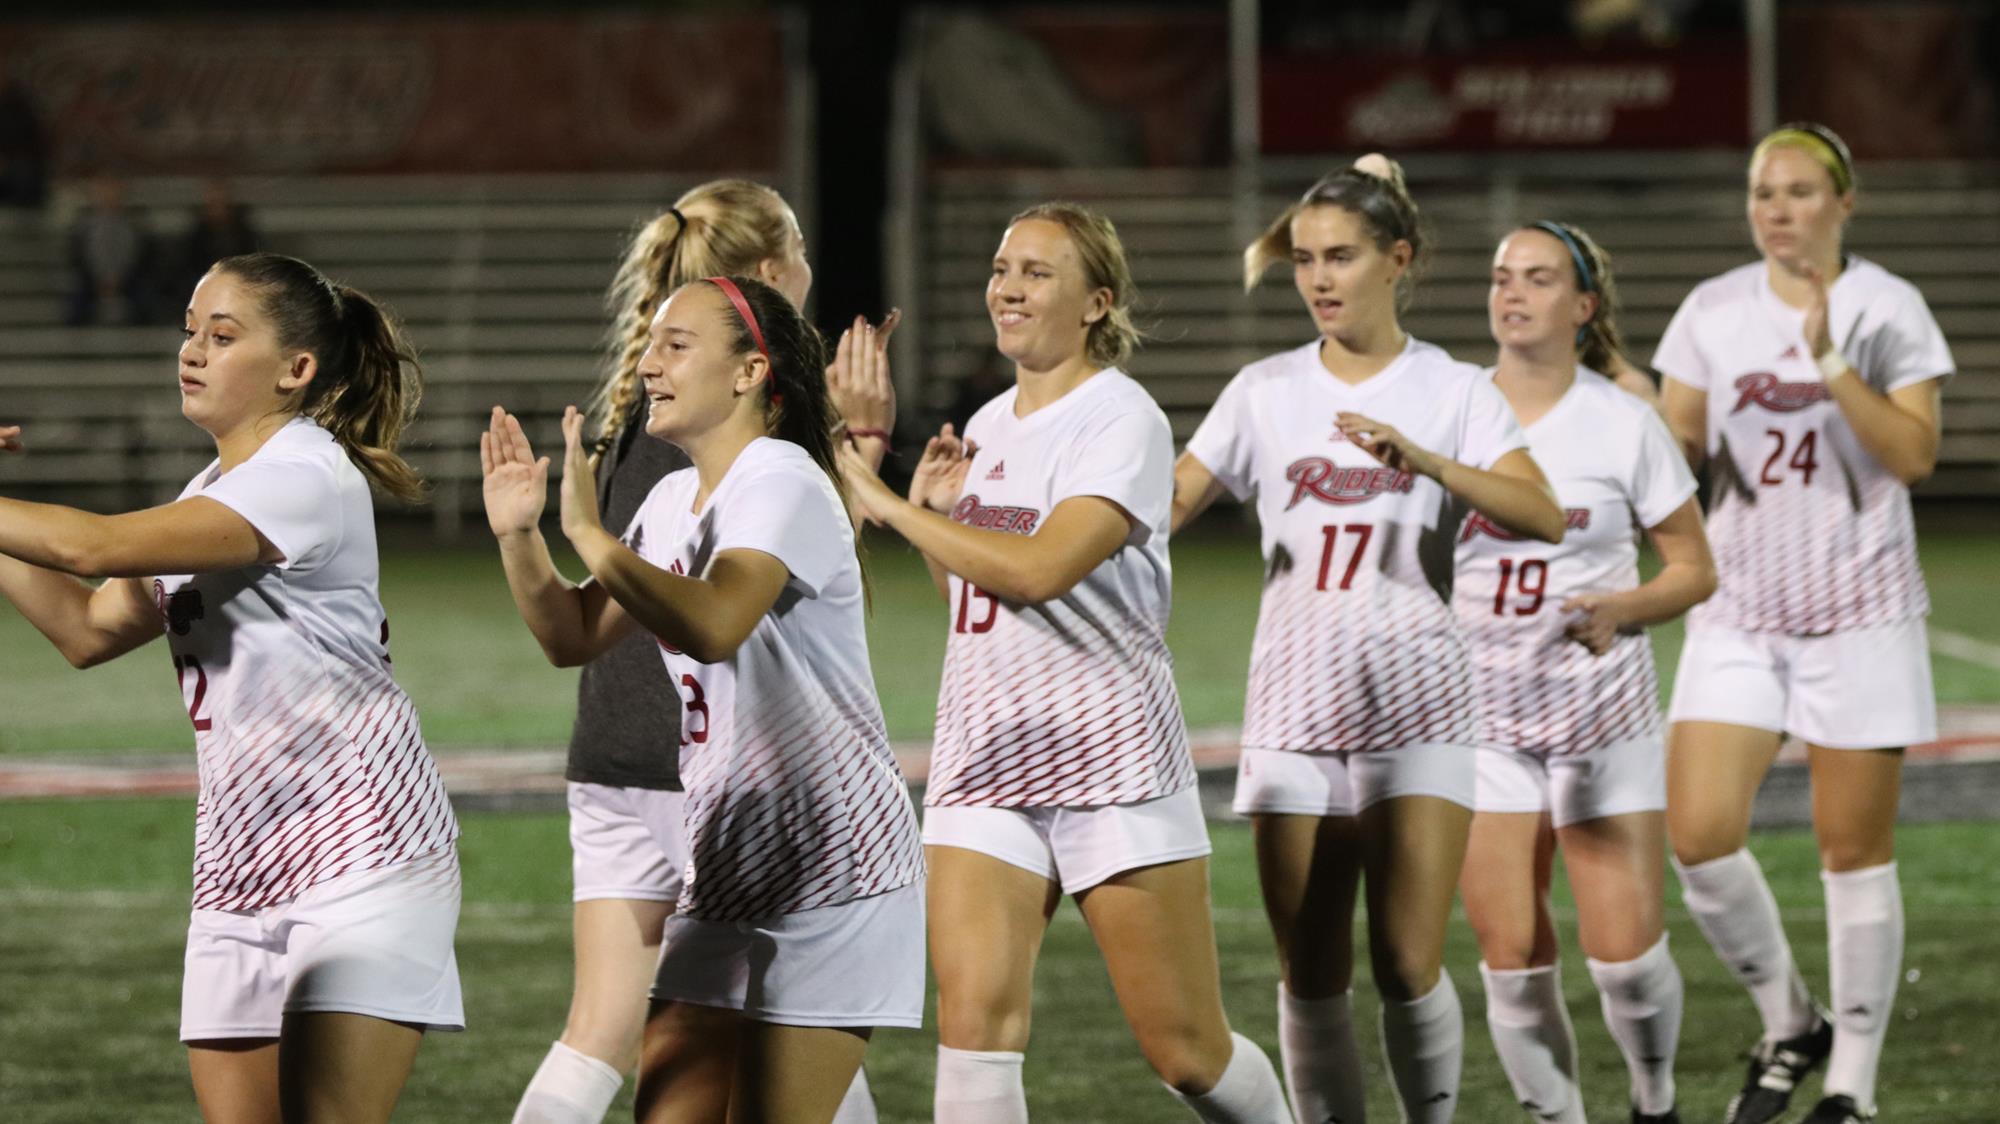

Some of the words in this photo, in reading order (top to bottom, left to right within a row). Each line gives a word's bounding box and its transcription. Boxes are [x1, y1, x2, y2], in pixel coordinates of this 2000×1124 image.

[1284, 456, 1416, 512] RIDER
[1760, 429, 1818, 486] 24
[1316, 524, 1373, 591] 17
[955, 579, 999, 634] 15
[1493, 558, 1548, 616] 19
[679, 673, 710, 746] 3
